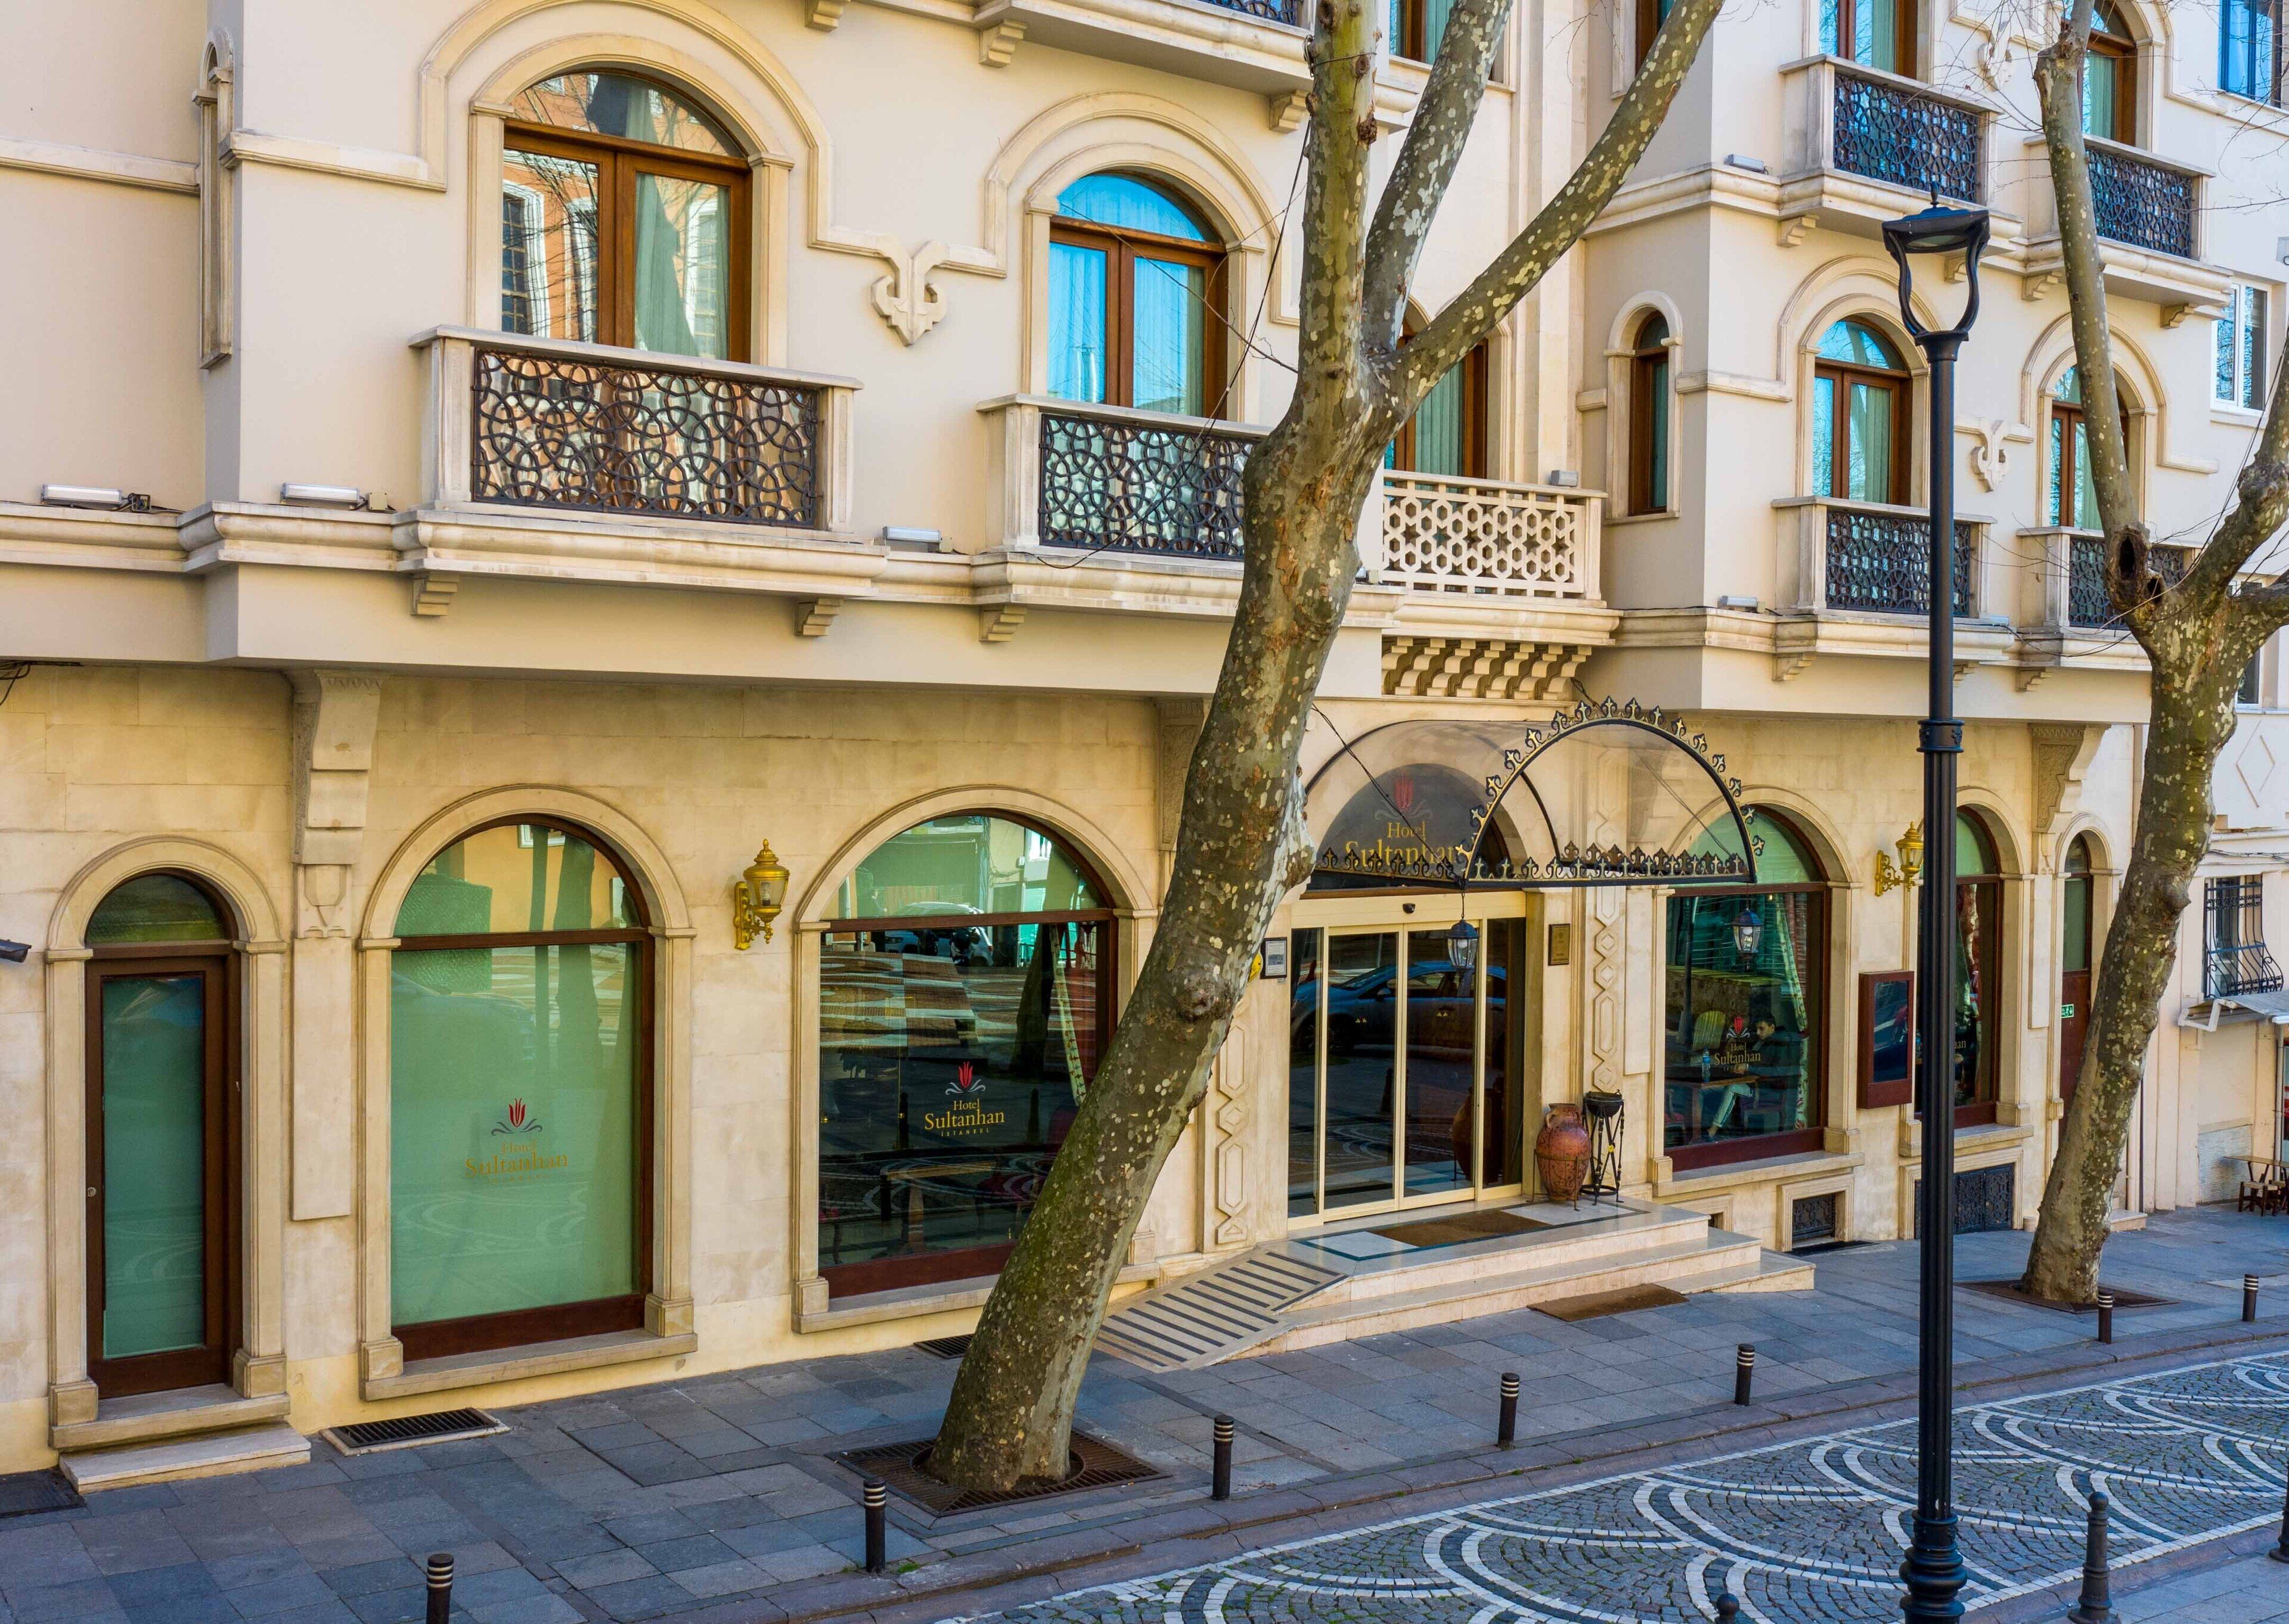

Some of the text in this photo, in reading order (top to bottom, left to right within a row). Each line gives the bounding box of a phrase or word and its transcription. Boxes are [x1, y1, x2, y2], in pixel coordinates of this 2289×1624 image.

[1387, 821, 1426, 839] Hotel
[1731, 1042, 1747, 1051] Hotel
[1714, 1050, 1761, 1066] Sultanhan
[953, 1099, 979, 1110] Hotel
[925, 1109, 1005, 1130] Sultanhan
[464, 1151, 568, 1179] Sultanhan
